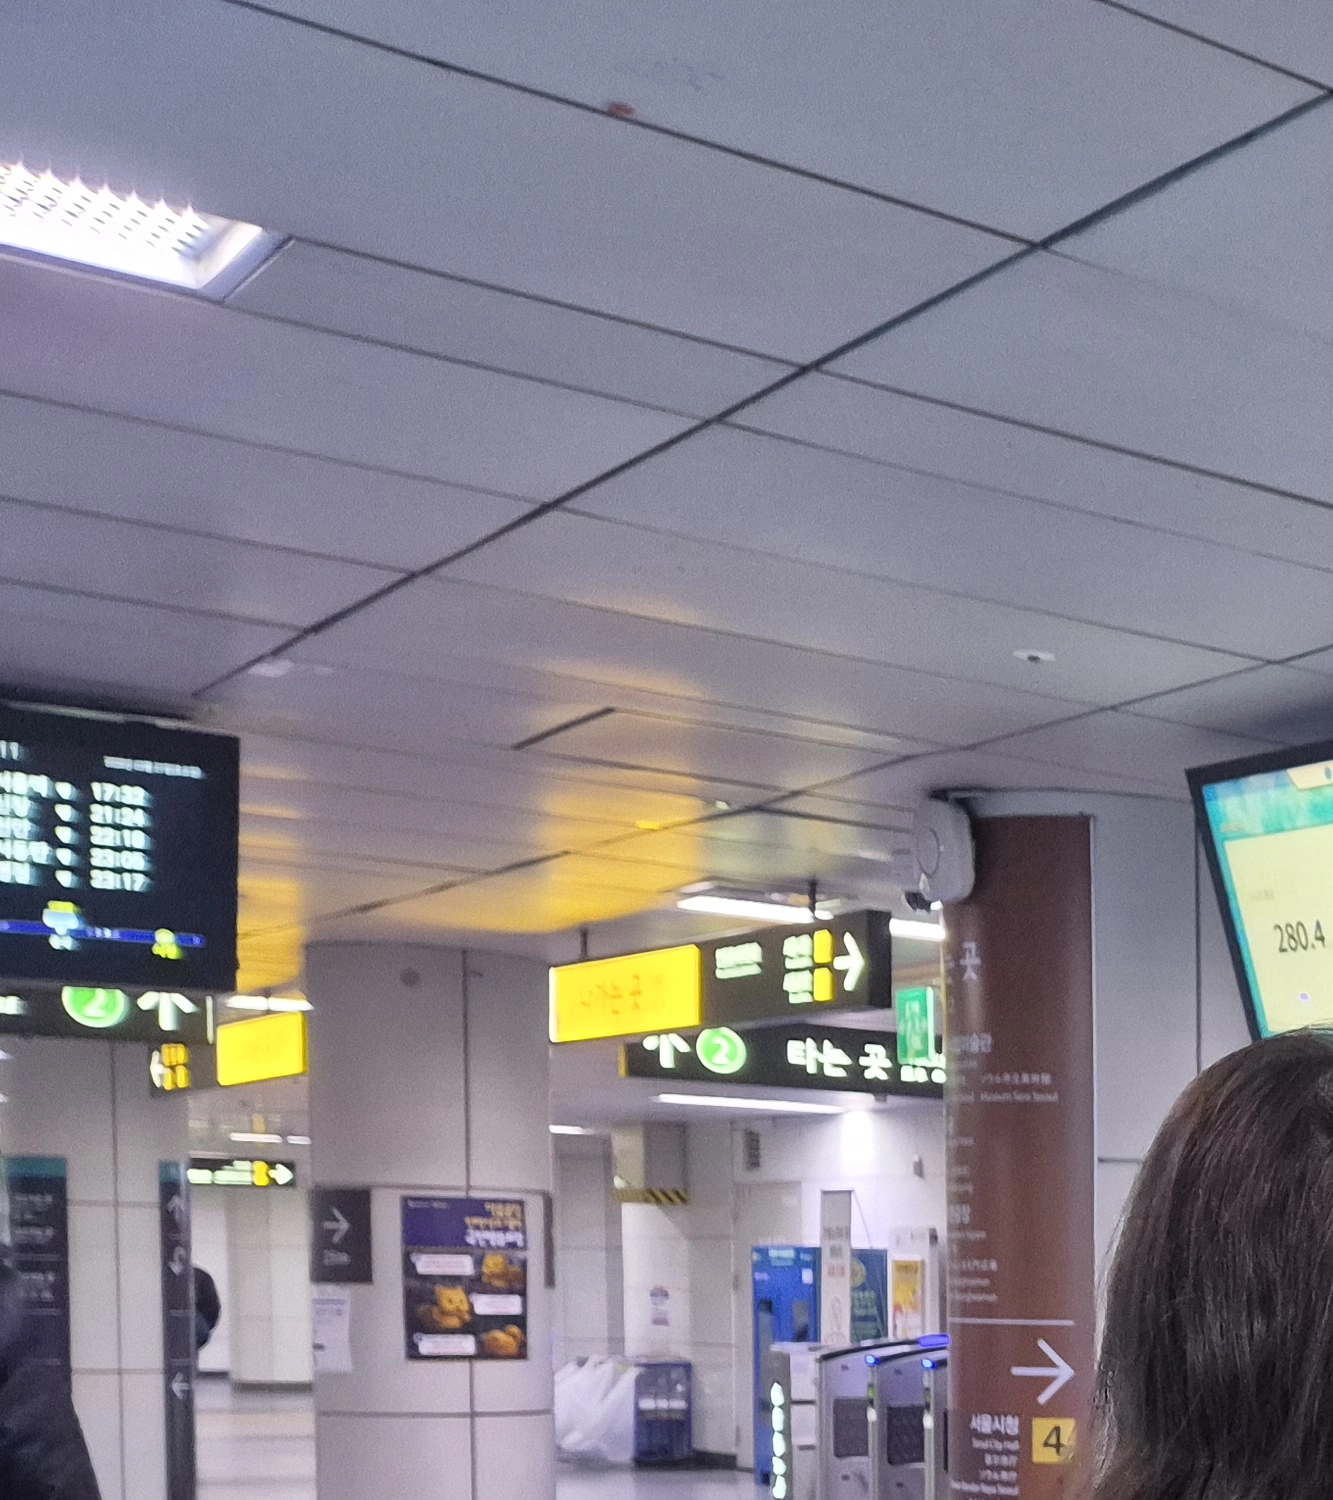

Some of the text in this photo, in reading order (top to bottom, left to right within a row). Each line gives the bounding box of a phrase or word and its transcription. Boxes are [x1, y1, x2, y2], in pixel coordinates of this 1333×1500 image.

[1273, 919, 1326, 953] 280.4
[960, 941, 982, 982] 곳
[786, 1036, 853, 1079] 타는
[858, 1042, 890, 1082] 곳
[970, 1412, 1020, 1436] 서울시청
[1043, 1425, 1066, 1456] 4
